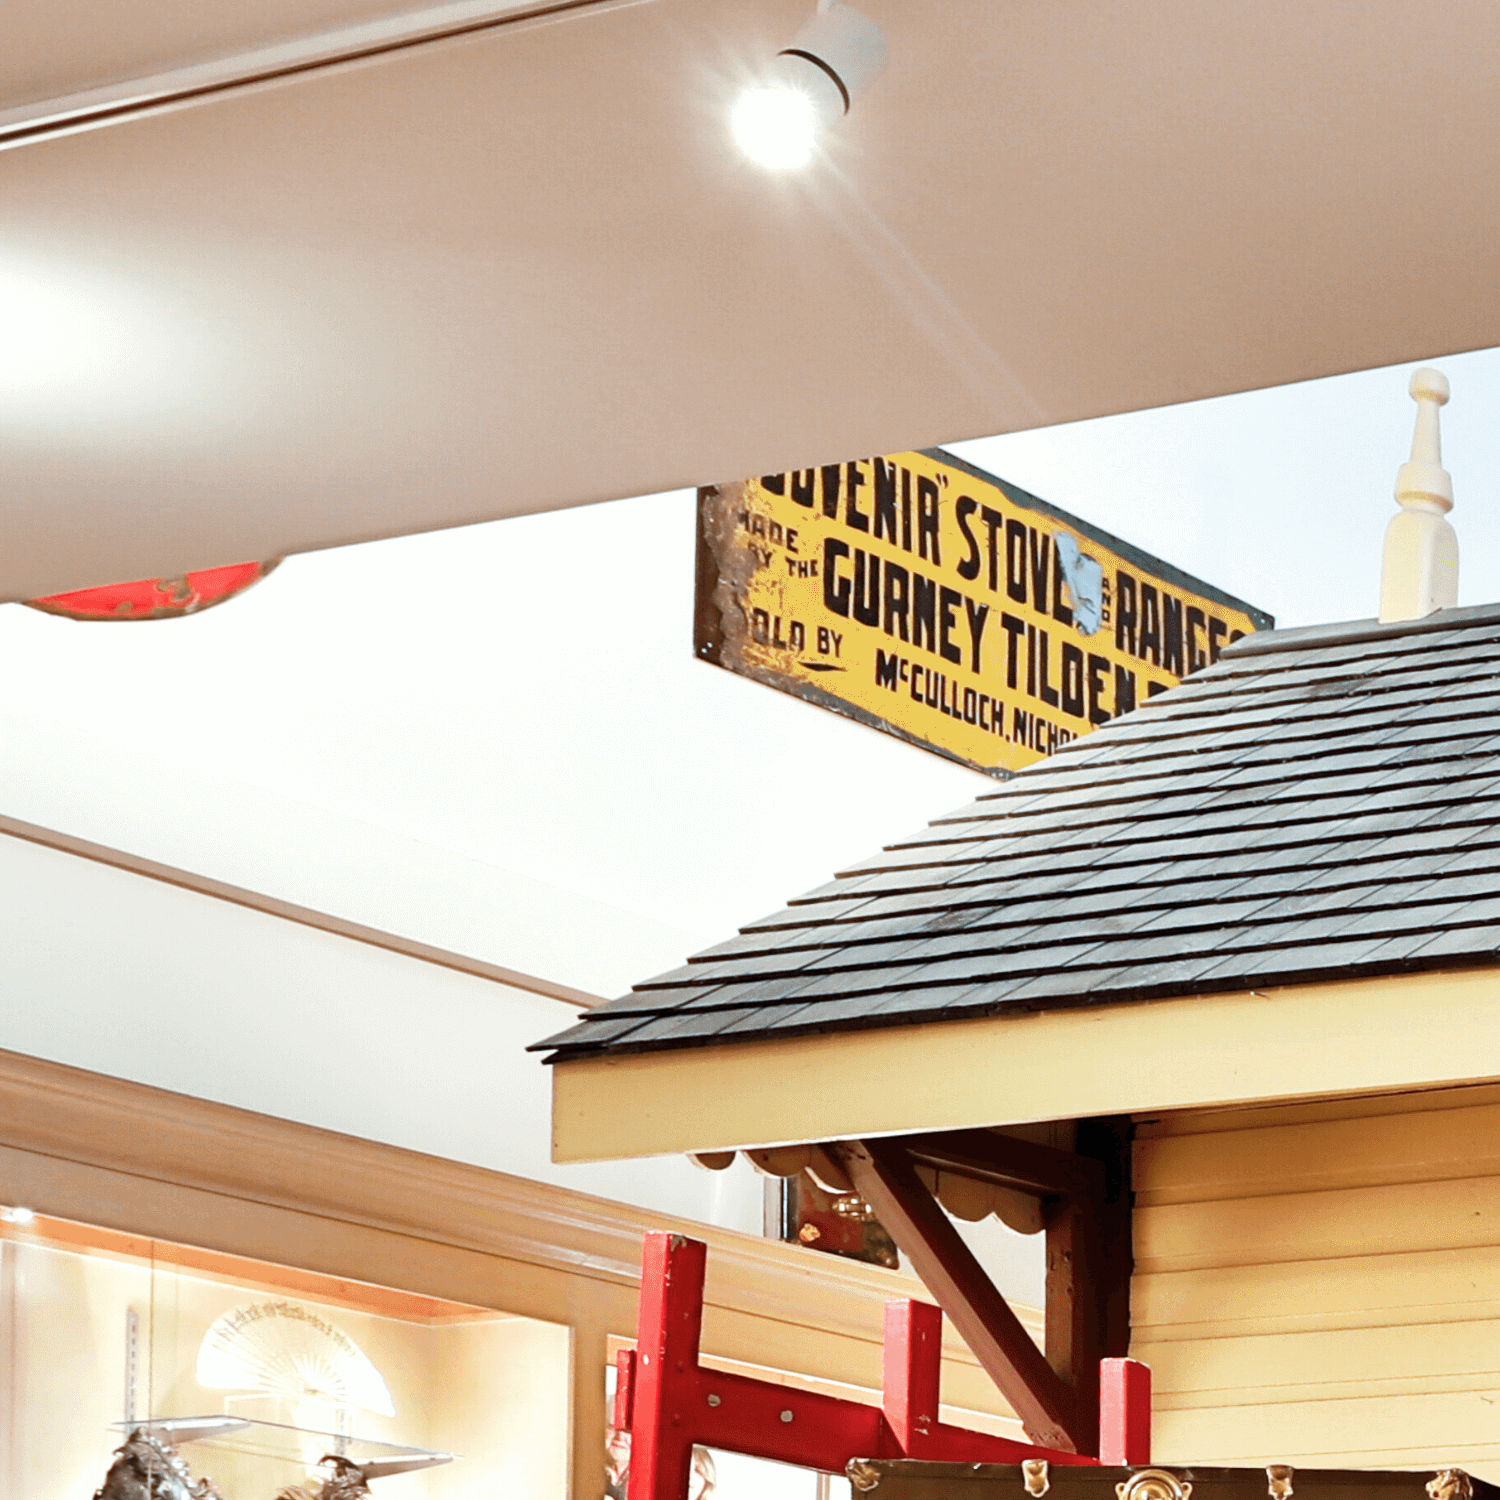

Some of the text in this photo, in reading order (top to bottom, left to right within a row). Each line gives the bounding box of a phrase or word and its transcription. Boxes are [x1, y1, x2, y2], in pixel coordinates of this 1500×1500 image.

[785, 556, 818, 579] THE
[817, 626, 844, 658] BY
[823, 537, 1136, 725] GURNEY TILDEN
[1013, 707, 1079, 757] NICH
